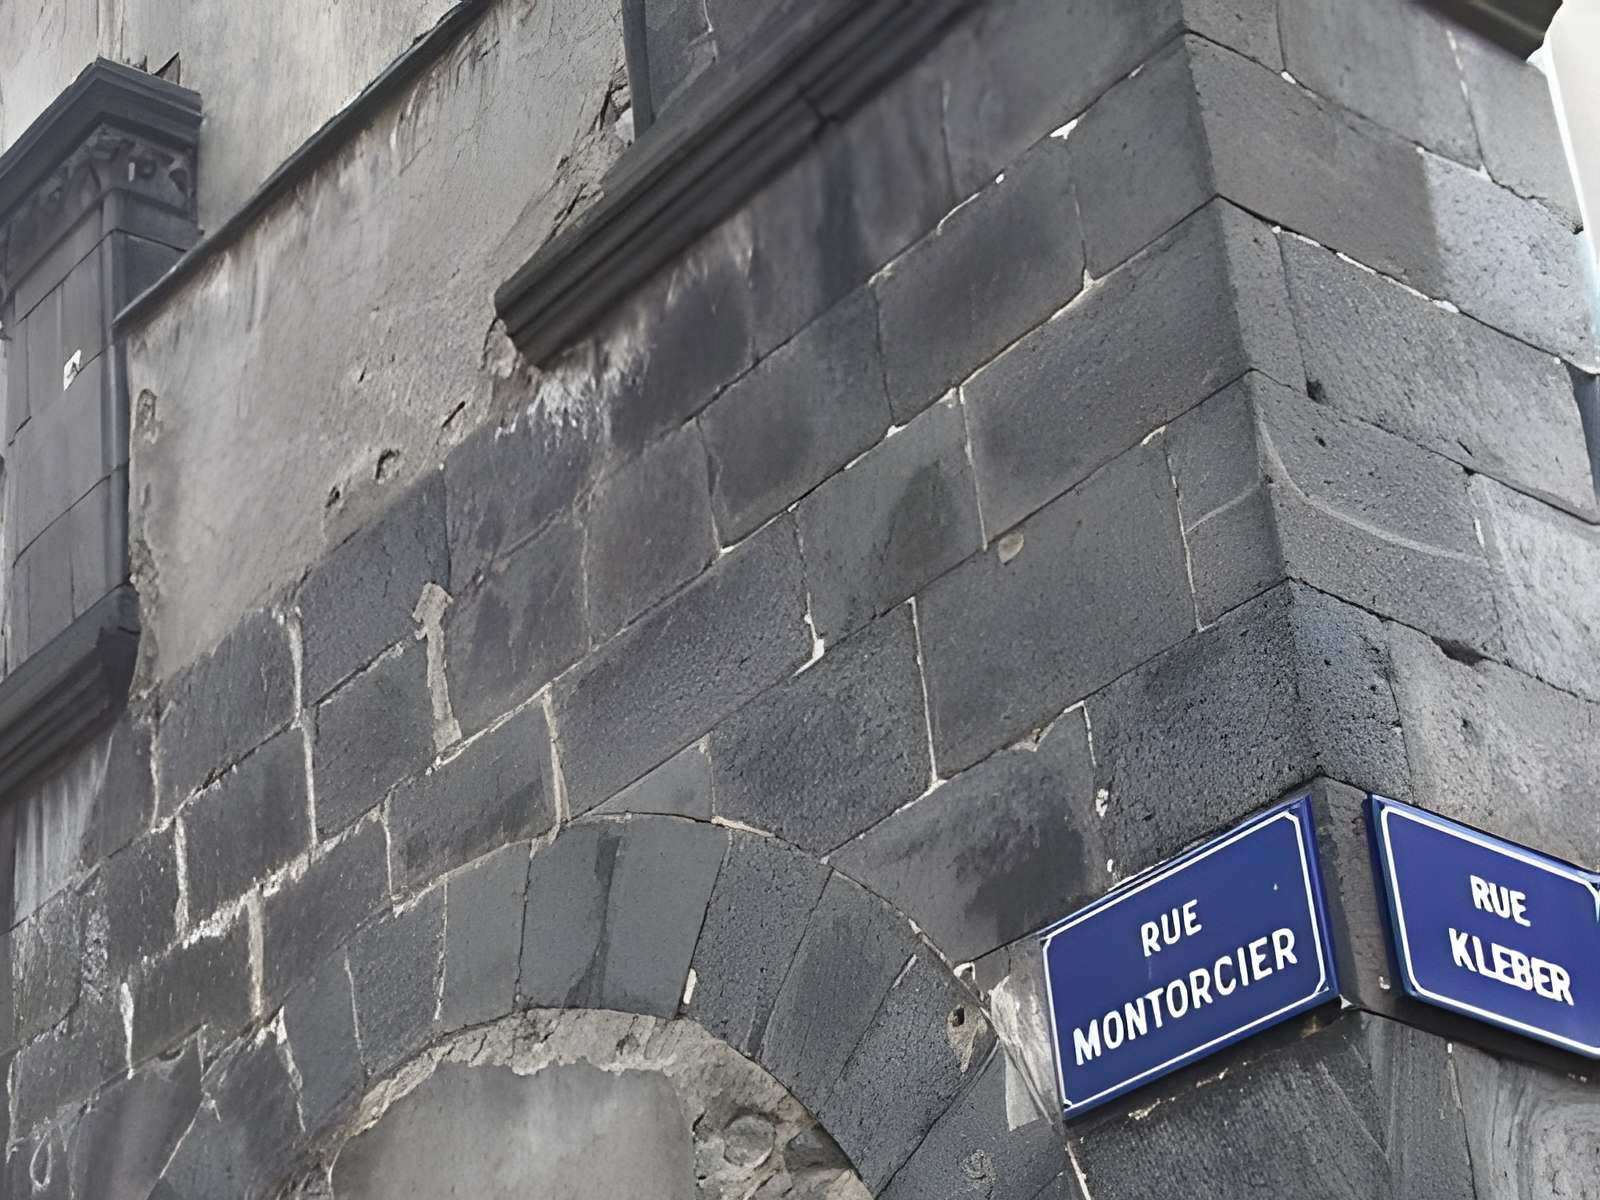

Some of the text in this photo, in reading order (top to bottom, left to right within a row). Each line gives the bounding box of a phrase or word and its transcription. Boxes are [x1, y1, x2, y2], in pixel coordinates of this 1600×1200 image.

[1140, 898, 1203, 958] RUE
[1469, 874, 1532, 928] RUE
[1073, 927, 1299, 1066] MONTORCIER
[1448, 927, 1575, 1007] KLEBER
